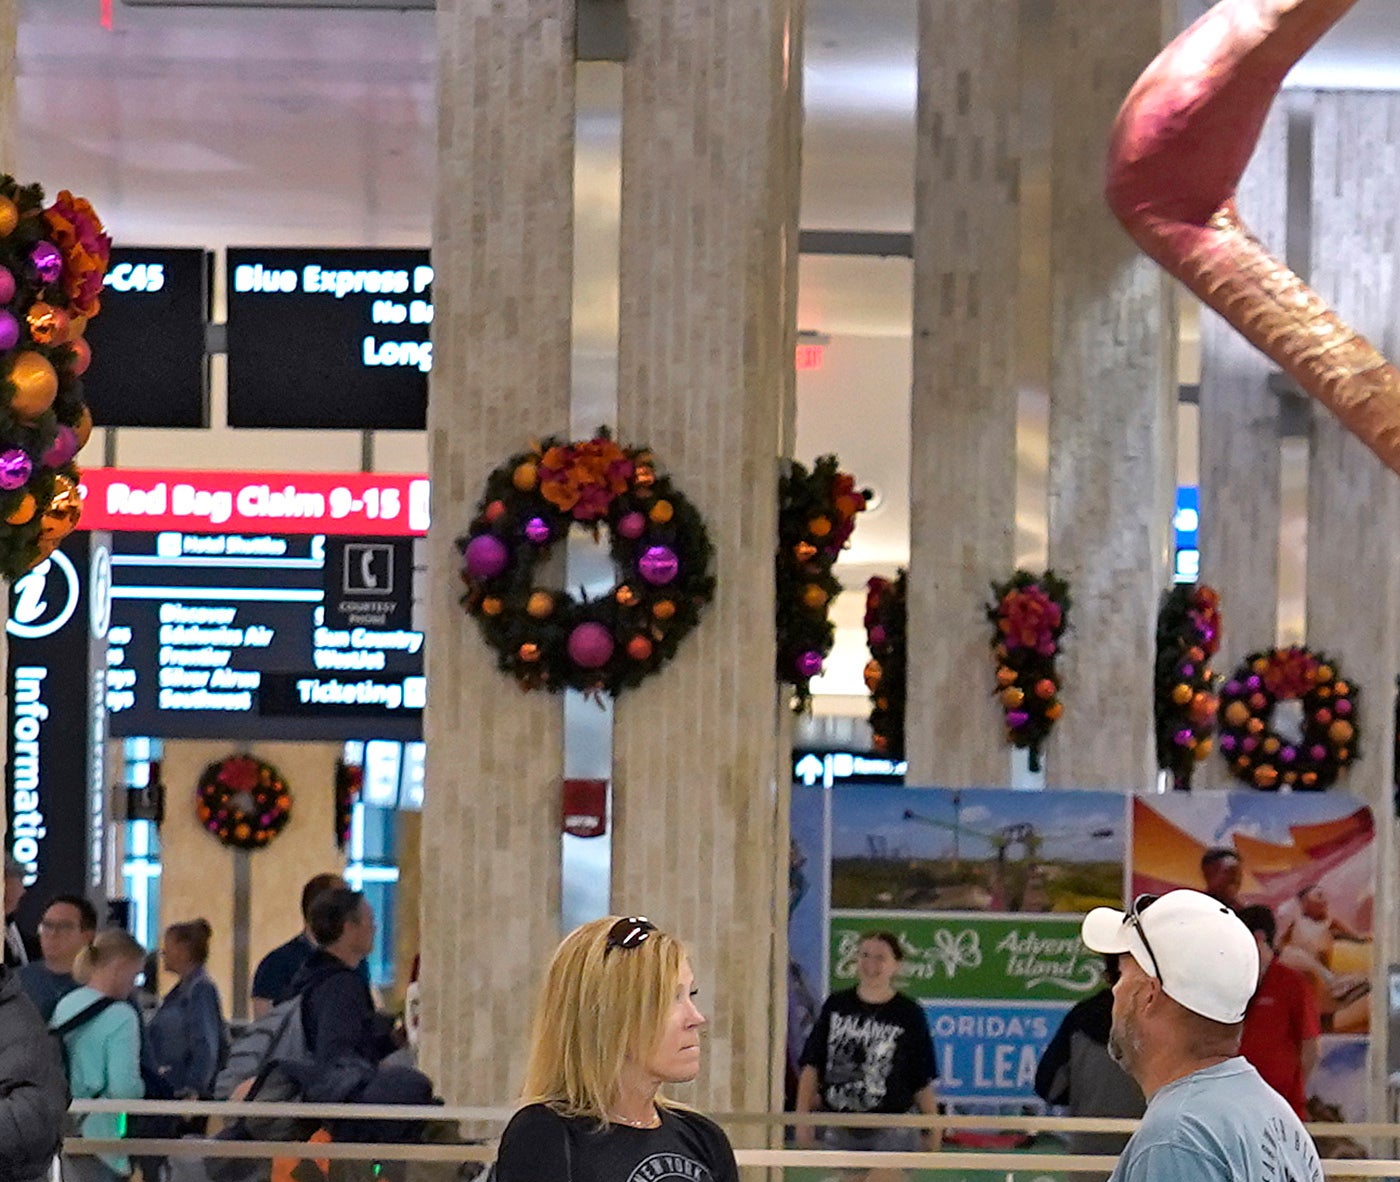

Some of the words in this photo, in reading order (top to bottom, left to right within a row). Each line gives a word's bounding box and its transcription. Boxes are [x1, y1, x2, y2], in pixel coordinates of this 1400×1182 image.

[235, 264, 298, 293] Blue
[303, 265, 410, 298] Express
[372, 300, 407, 324] No
[106, 482, 168, 516] Red
[172, 483, 233, 524] Bag
[237, 484, 326, 519] Claim
[329, 486, 401, 520] 9-15
[243, 625, 275, 647] Air
[314, 626, 350, 649] Sun
[351, 627, 425, 655] Country
[297, 679, 403, 710] Ticketing
[934, 1015, 1049, 1039] ORIDA'S
[664, 1156, 702, 1181] YORK
